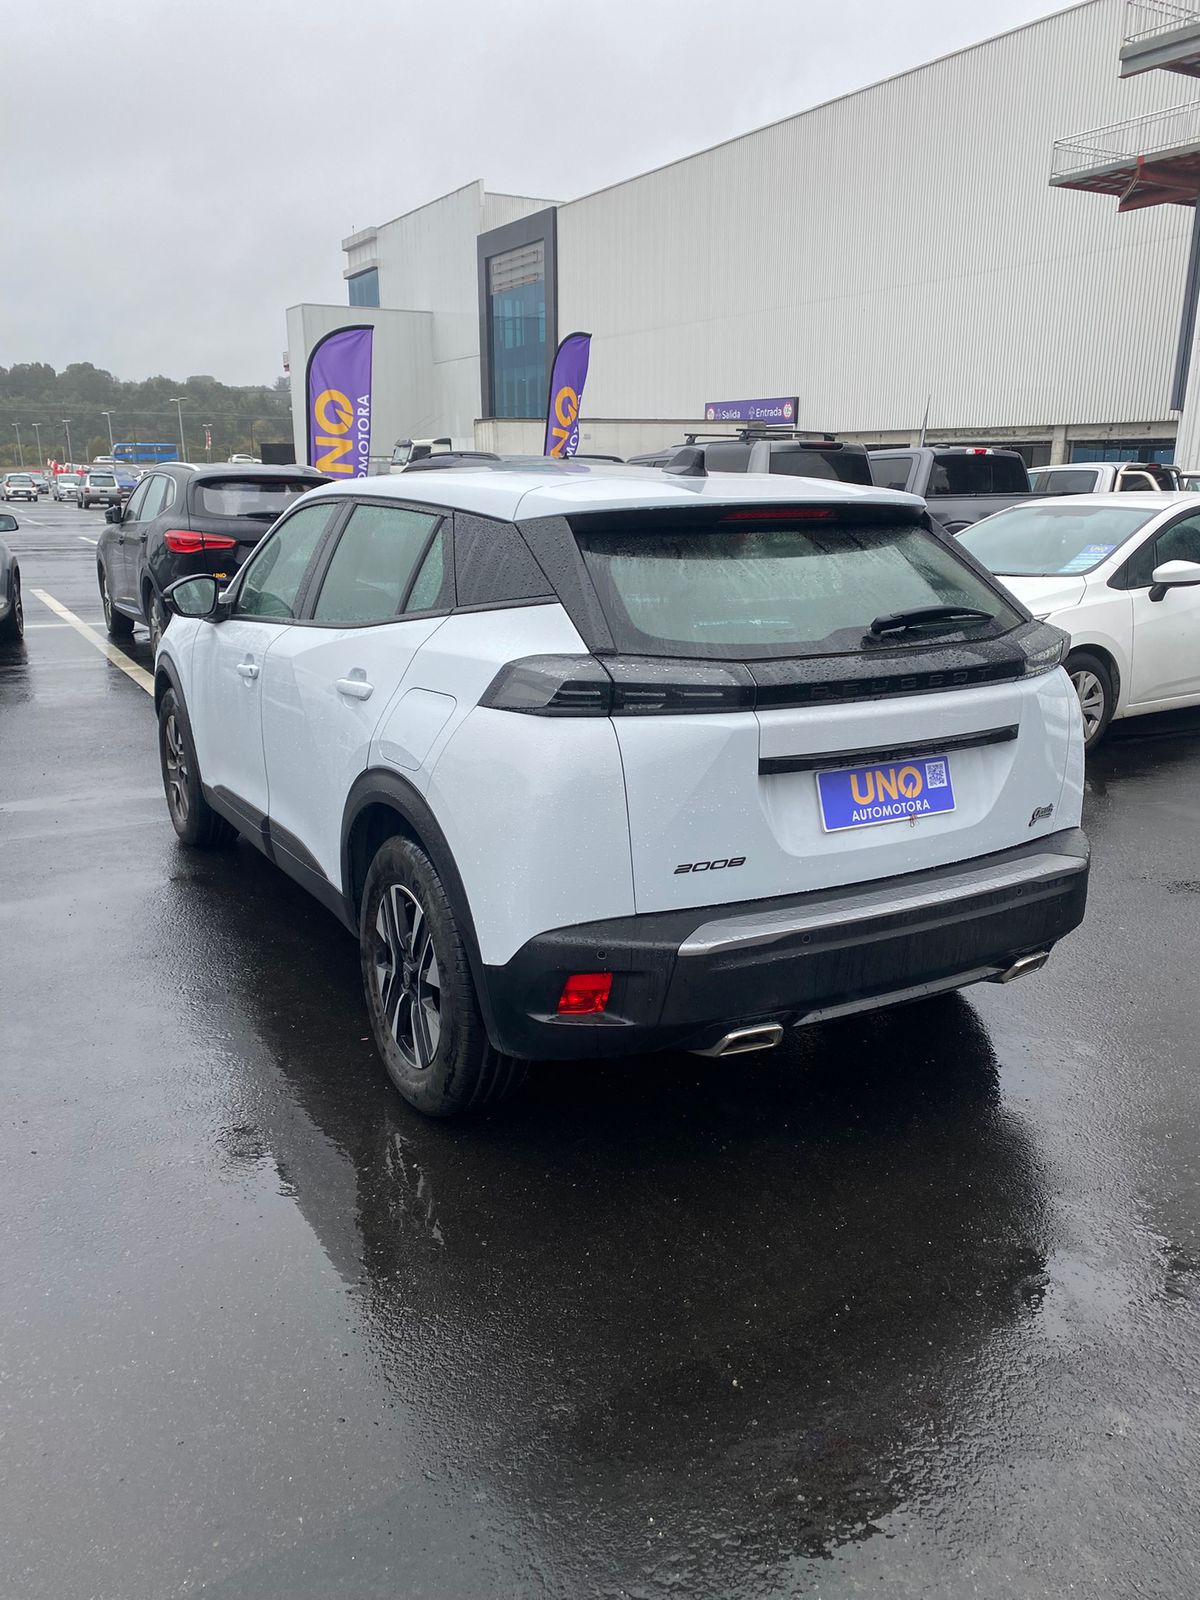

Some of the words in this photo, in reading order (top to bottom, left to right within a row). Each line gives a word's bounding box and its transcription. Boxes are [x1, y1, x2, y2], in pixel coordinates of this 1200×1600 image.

[721, 409, 741, 419] Salida
[755, 406, 782, 418] Entrada
[314, 389, 354, 480] NO
[811, 669, 993, 699] PEUGEOT
[849, 766, 923, 806] UNO
[852, 799, 931, 822] AUTOMOTORA
[673, 856, 747, 874] 2008
